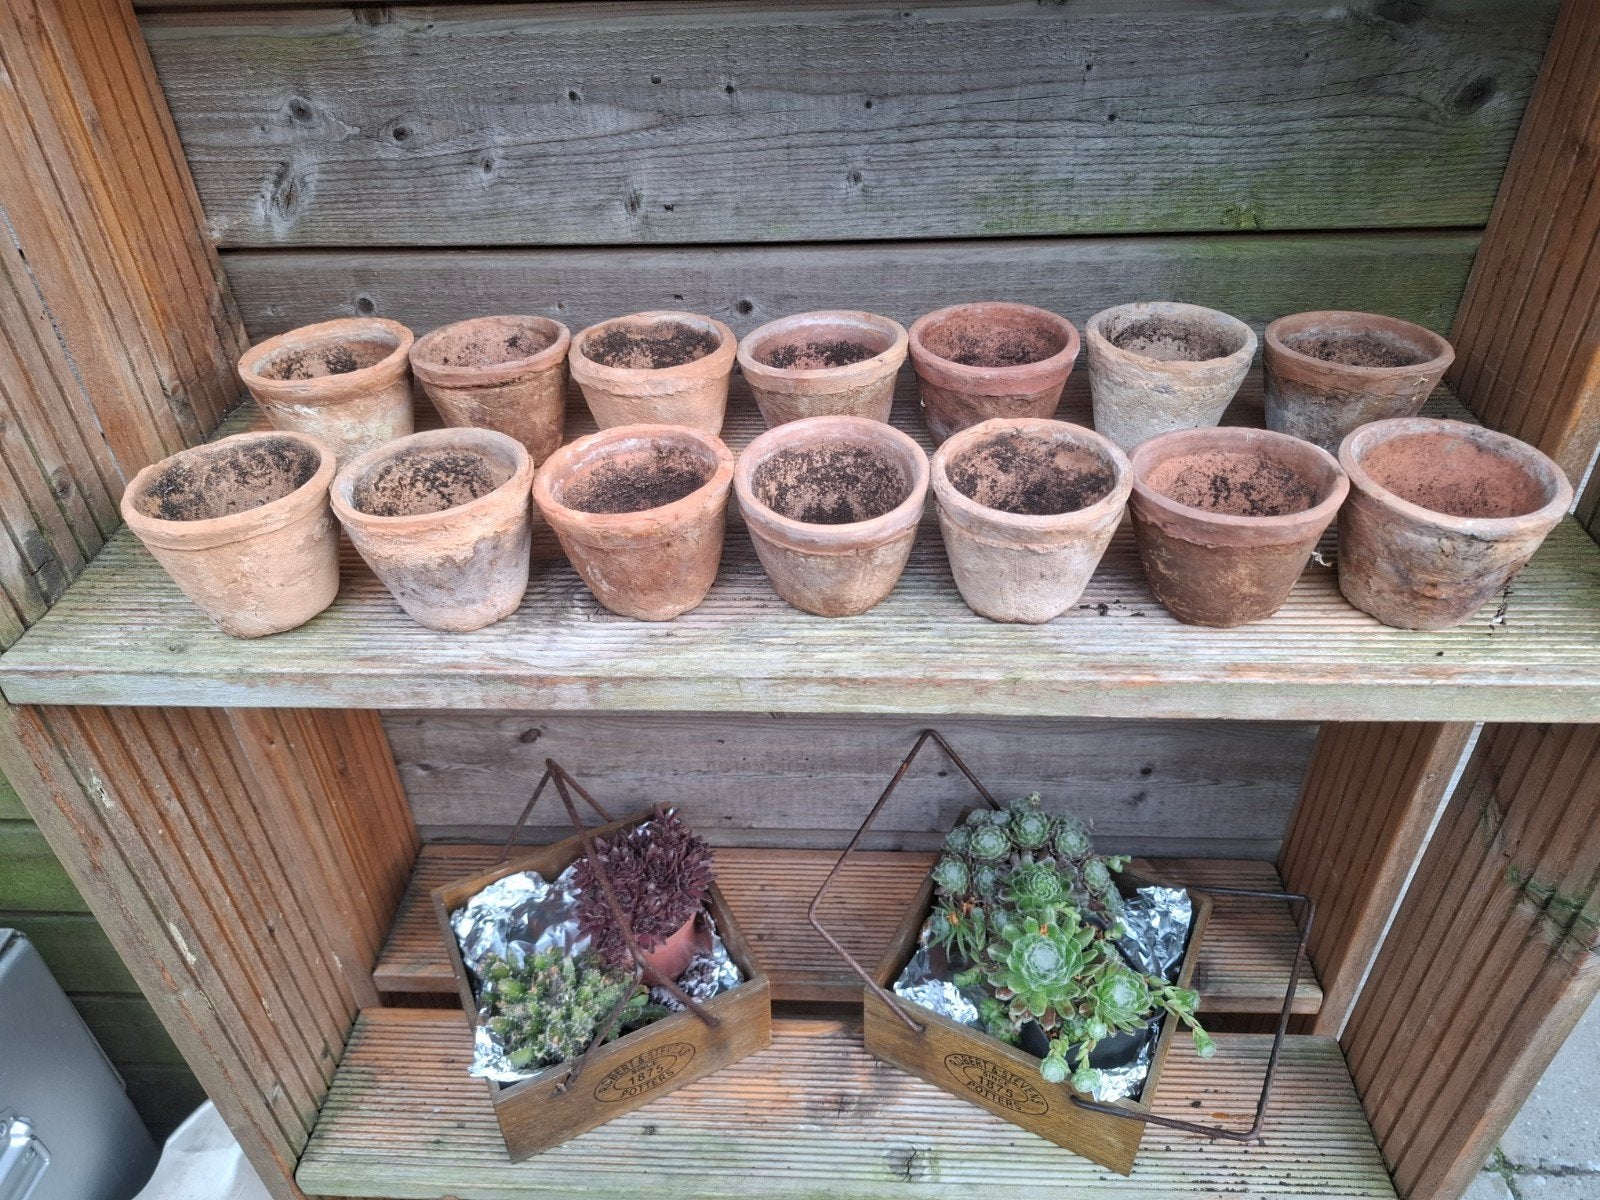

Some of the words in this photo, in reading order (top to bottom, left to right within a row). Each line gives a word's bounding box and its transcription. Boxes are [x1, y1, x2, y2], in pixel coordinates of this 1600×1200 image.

[599, 1059, 635, 1093] ROBERT
[629, 1064, 663, 1085] 1875
[631, 1060, 657, 1075] SINCE
[949, 1056, 987, 1070] ROBERT
[991, 1065, 998, 1075] &
[620, 1070, 674, 1098] POTTERS
[978, 1076, 1014, 1098] 1875
[983, 1071, 1007, 1087] SINCE
[967, 1081, 1022, 1111] POTTERS
